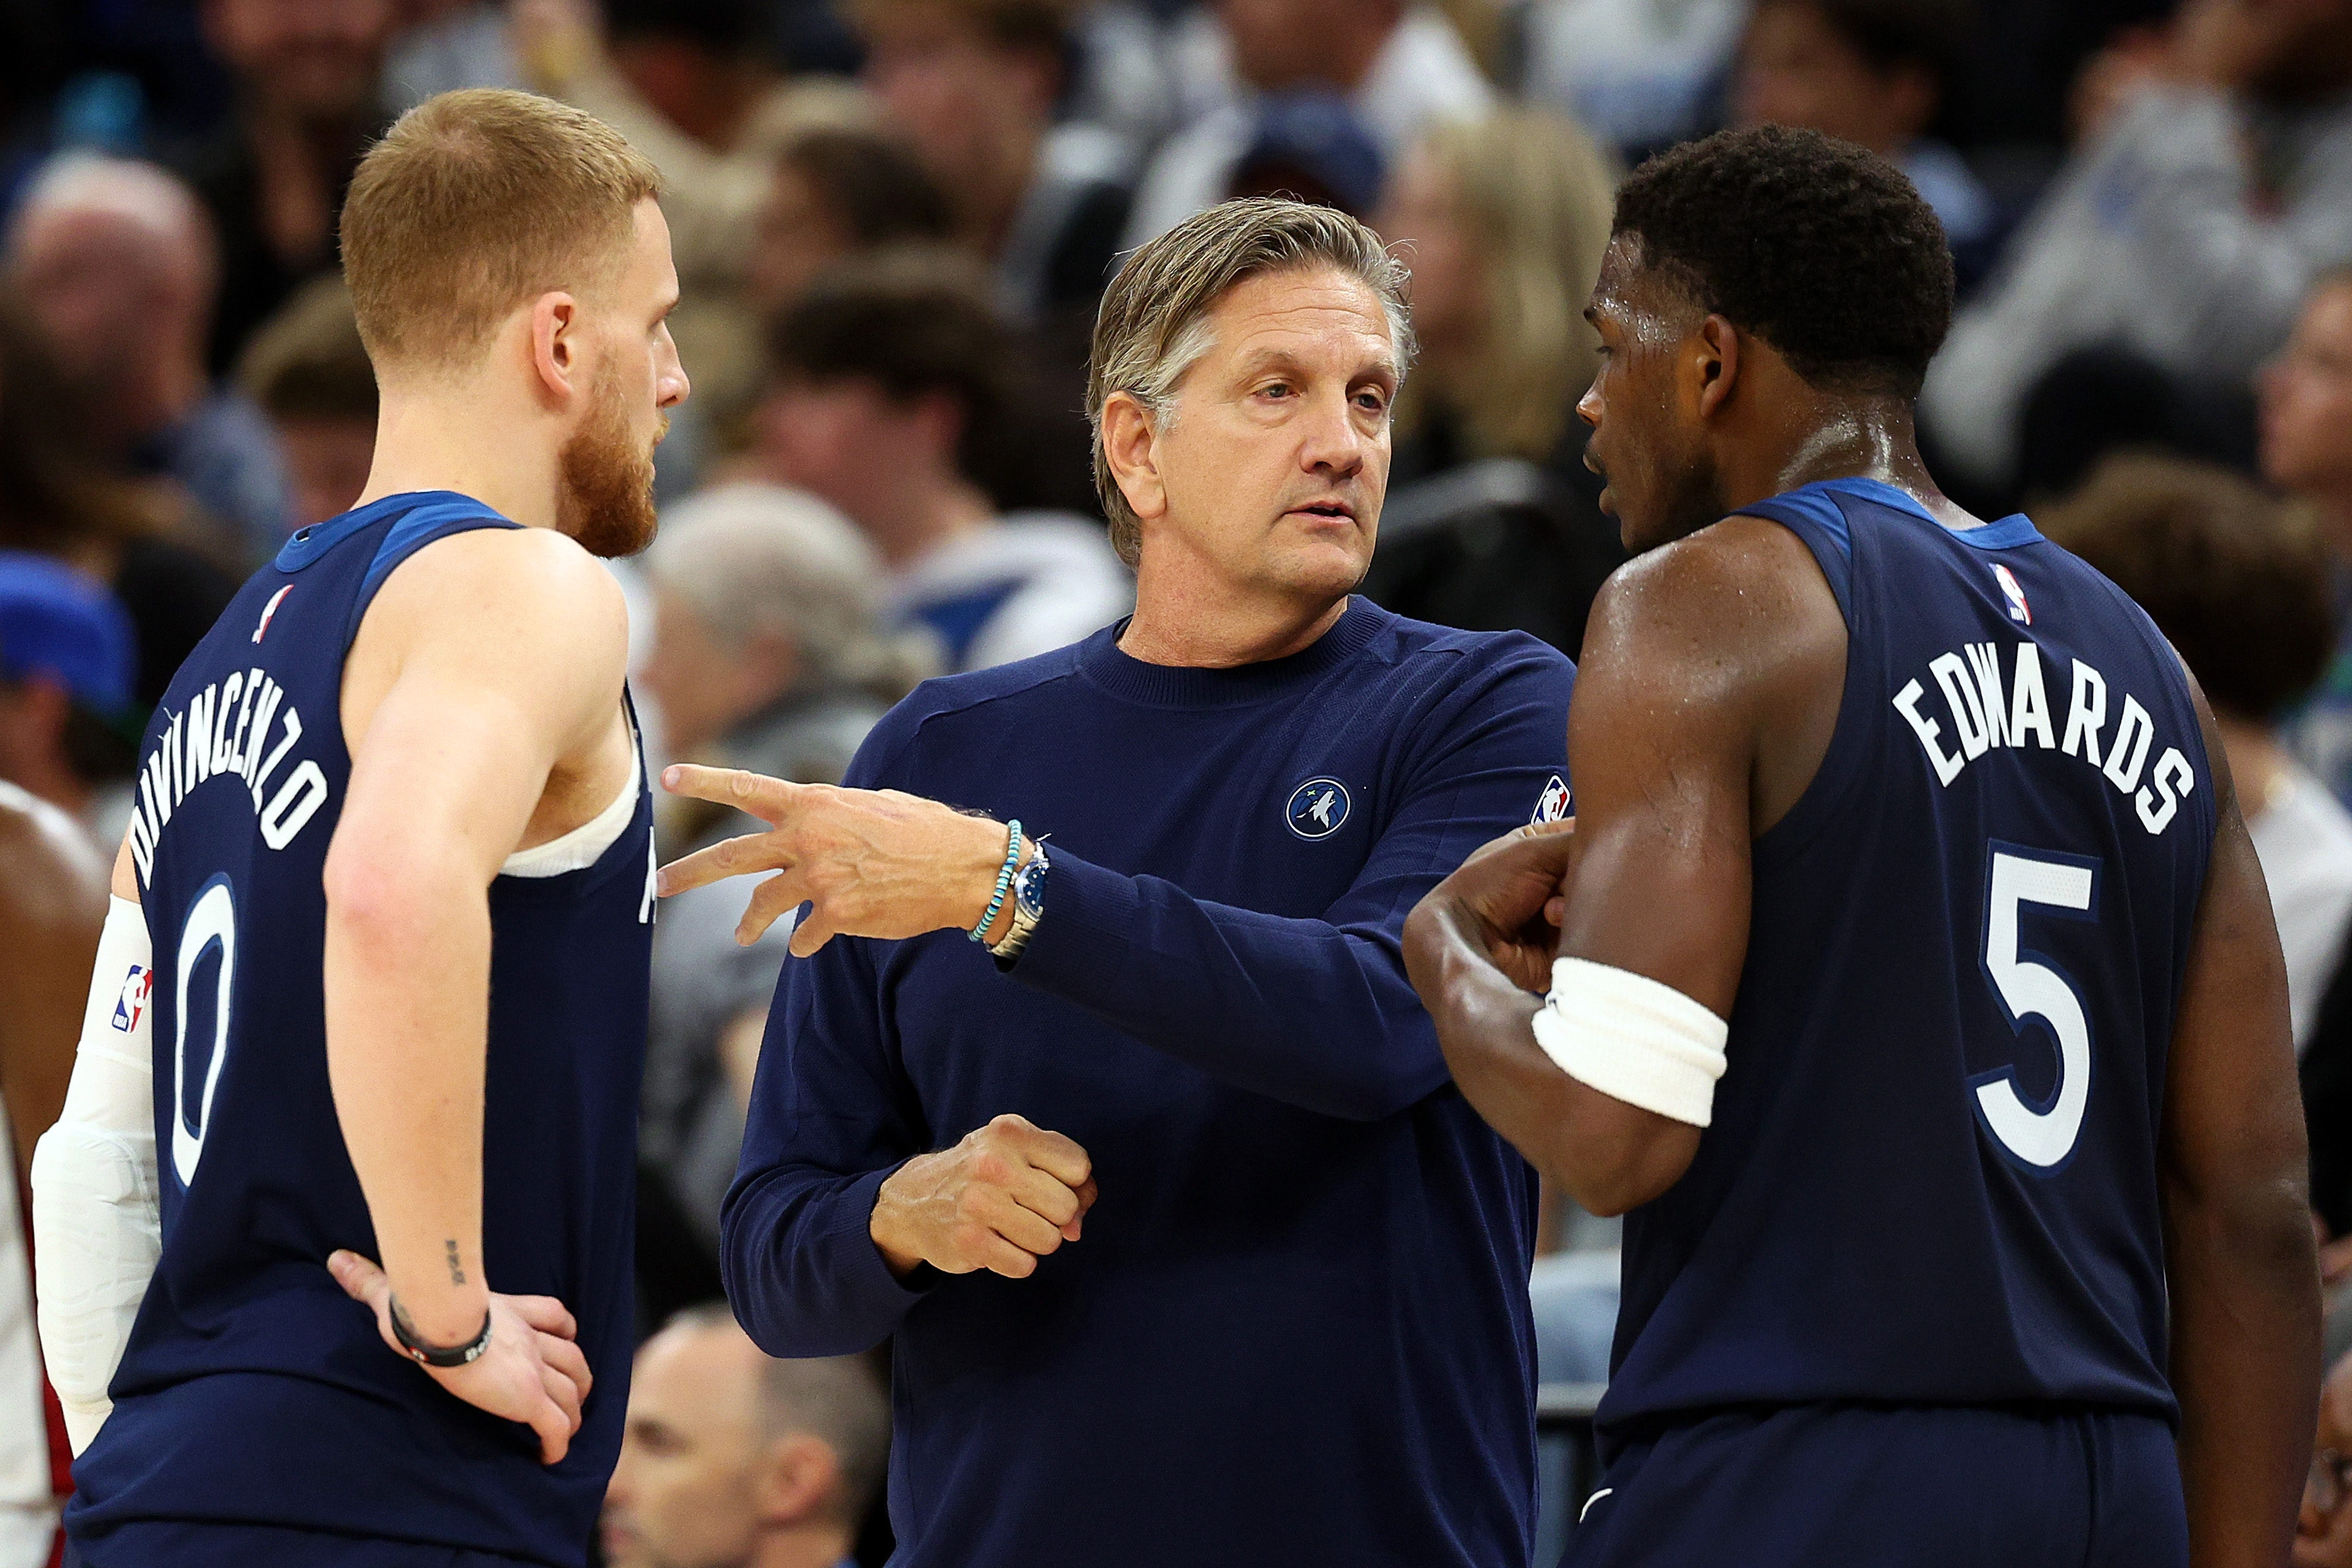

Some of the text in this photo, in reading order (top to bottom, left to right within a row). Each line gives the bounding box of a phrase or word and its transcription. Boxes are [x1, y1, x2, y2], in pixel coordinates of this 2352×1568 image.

[2010, 607, 2025, 621] NBA
[128, 667, 328, 891] DIVINCENZO
[1892, 641, 2194, 835] EDWARDS
[113, 1013, 128, 1029] NBA
[171, 877, 237, 1189] 0
[1973, 849, 2096, 1171] 5
